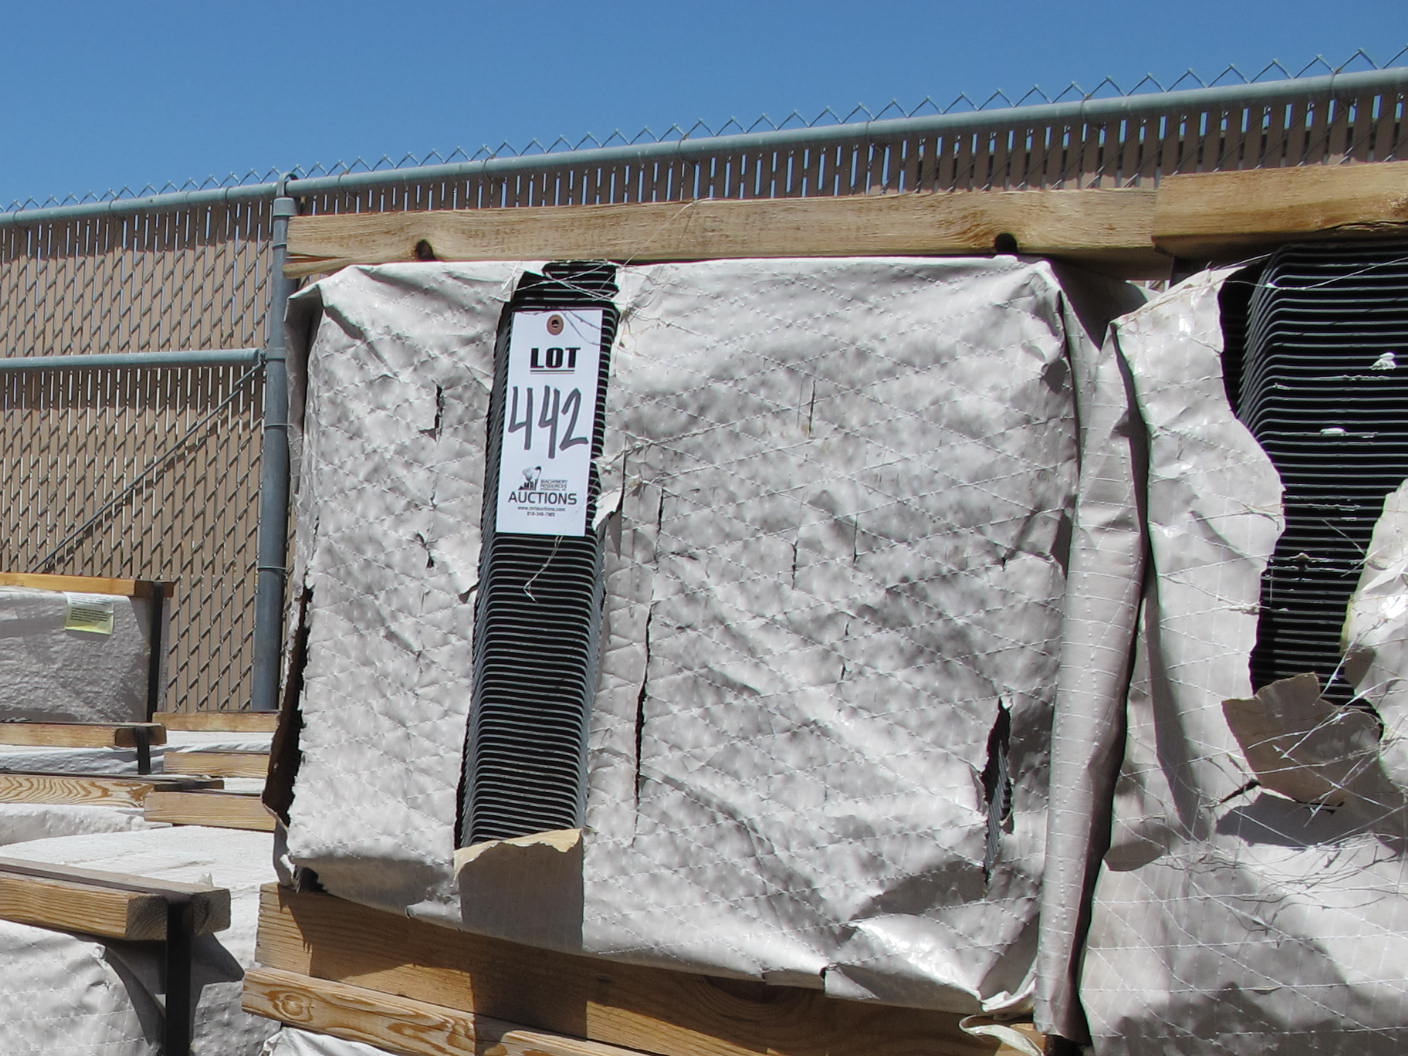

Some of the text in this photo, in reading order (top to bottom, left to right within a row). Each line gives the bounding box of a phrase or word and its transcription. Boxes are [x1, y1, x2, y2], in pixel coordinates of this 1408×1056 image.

[530, 347, 581, 369] LOT
[508, 385, 589, 459] 442
[508, 491, 577, 505] AUCTIONS
